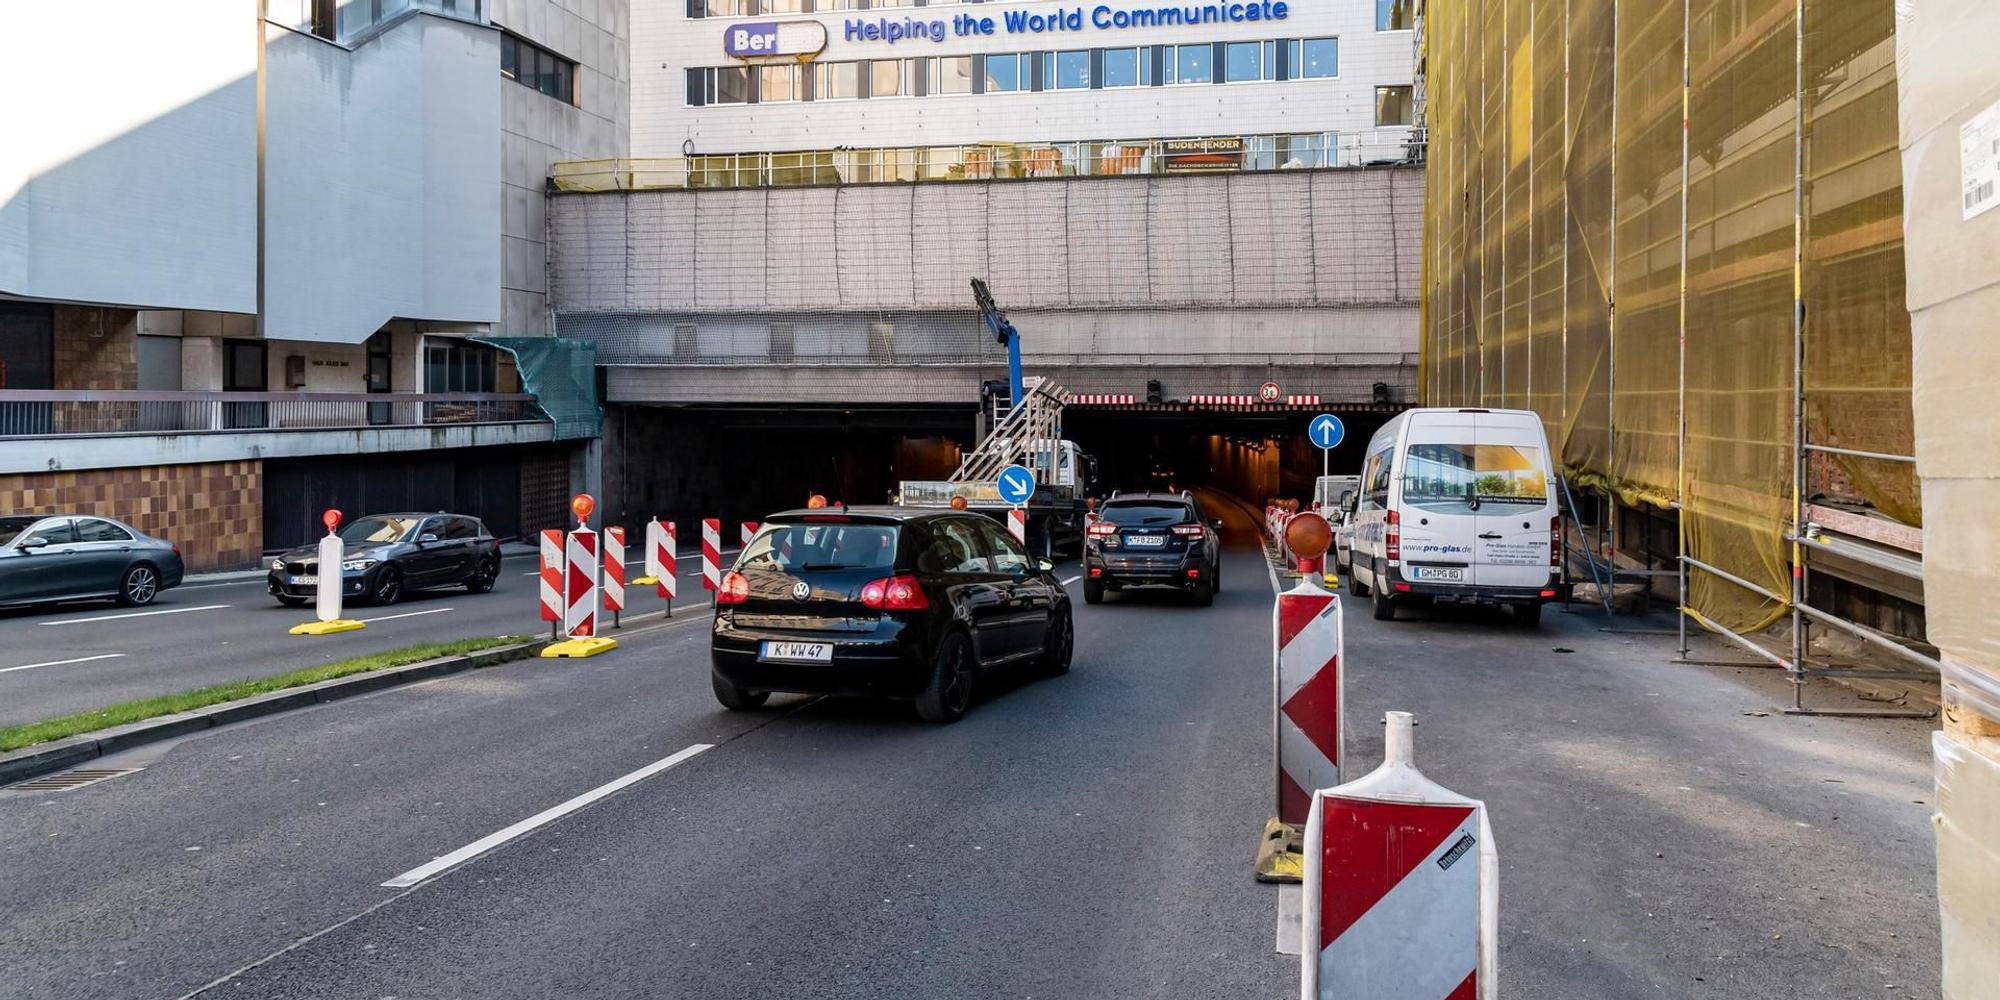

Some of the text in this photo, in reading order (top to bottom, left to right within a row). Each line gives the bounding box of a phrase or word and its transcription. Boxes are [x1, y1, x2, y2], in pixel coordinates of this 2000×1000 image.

[844, 0, 1288, 44] Helping the World Communicate
[734, 30, 776, 50] Ber
[1402, 544, 1473, 554] www.pro-glas.de
[1421, 568, 1433, 577] GM
[1437, 569, 1447, 577] PG
[775, 643, 823, 658] K WW 47
